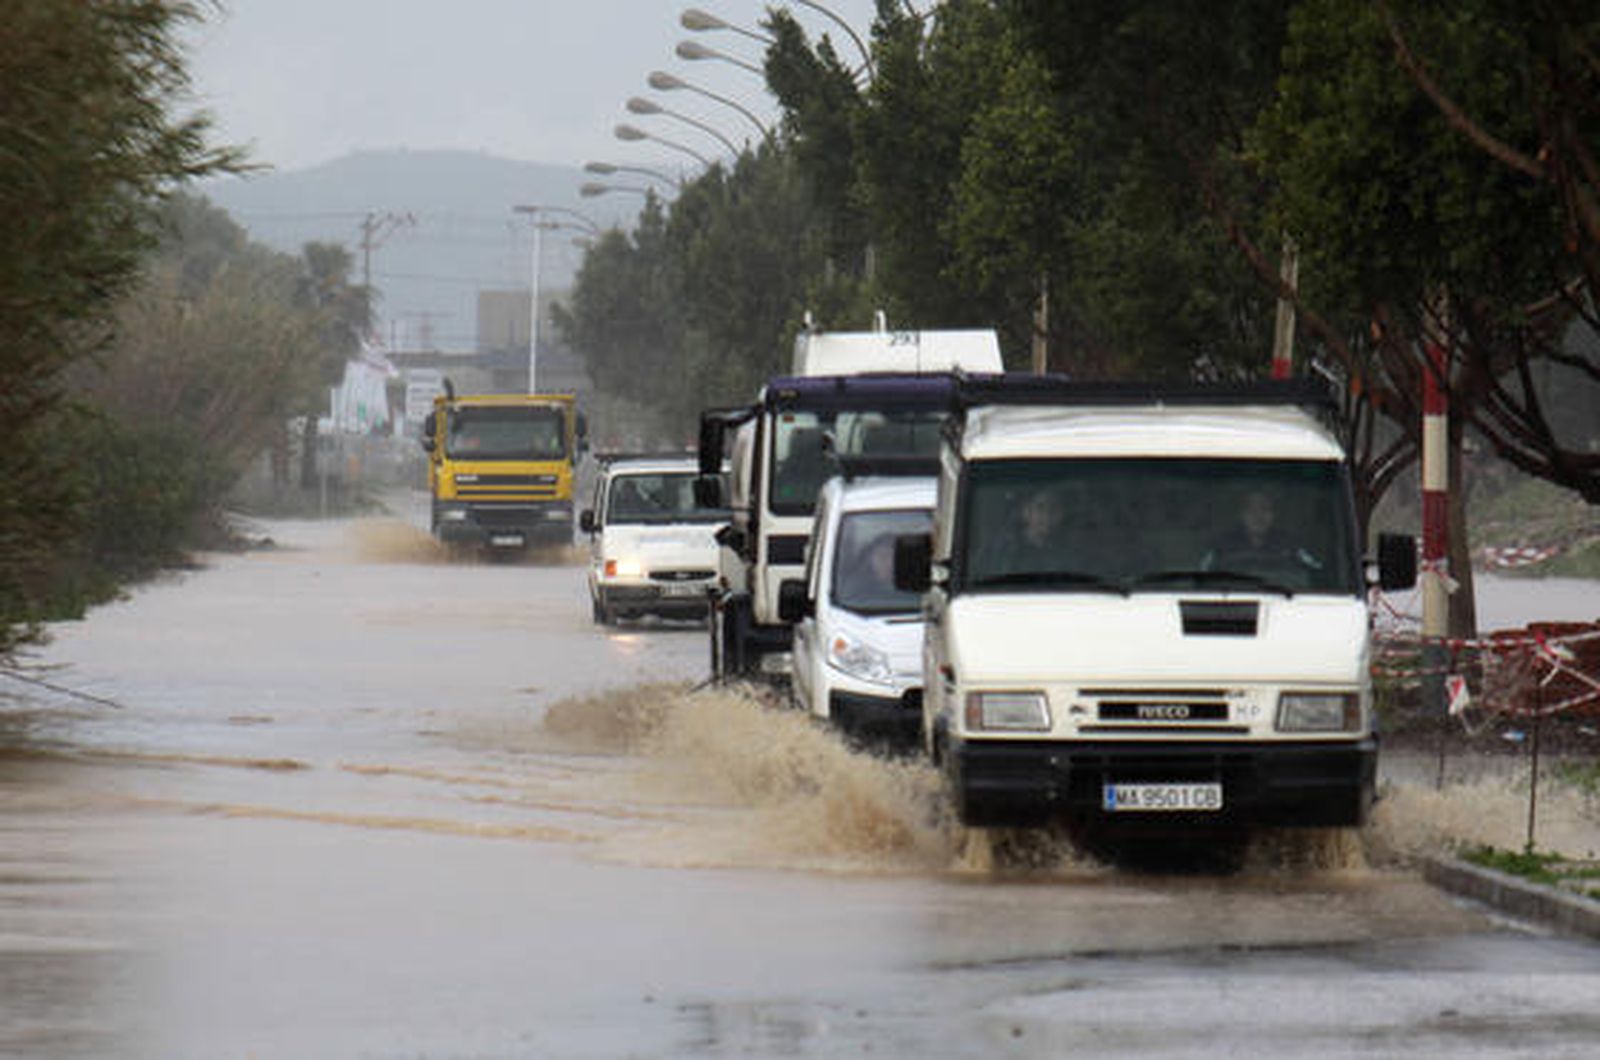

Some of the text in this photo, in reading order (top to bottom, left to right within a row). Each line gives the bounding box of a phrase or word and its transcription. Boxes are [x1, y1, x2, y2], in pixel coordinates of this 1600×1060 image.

[1137, 705, 1190, 719] IVECO
[1116, 788, 1218, 806] MA 9501 CB
